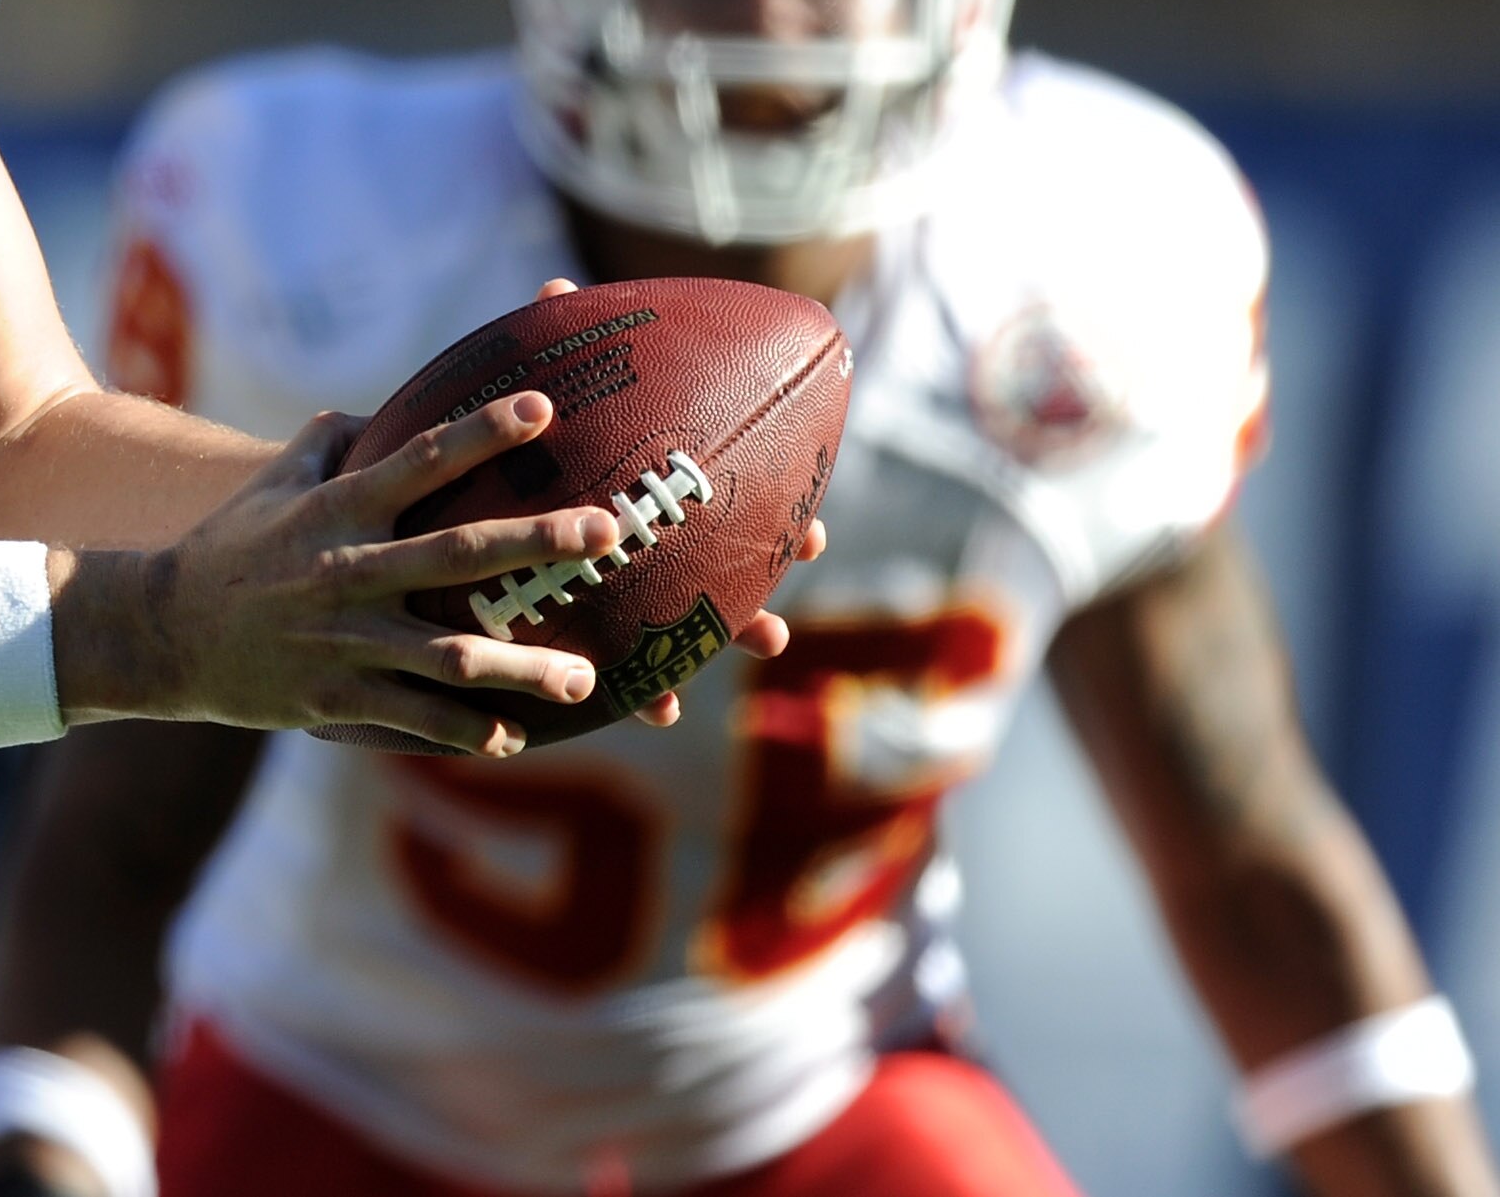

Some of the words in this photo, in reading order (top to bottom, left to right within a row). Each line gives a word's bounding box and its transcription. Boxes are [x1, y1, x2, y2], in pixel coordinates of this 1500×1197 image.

[534, 308, 660, 365] NATIONAL
[437, 363, 529, 428] FOOTB
[621, 630, 720, 712] NFL
